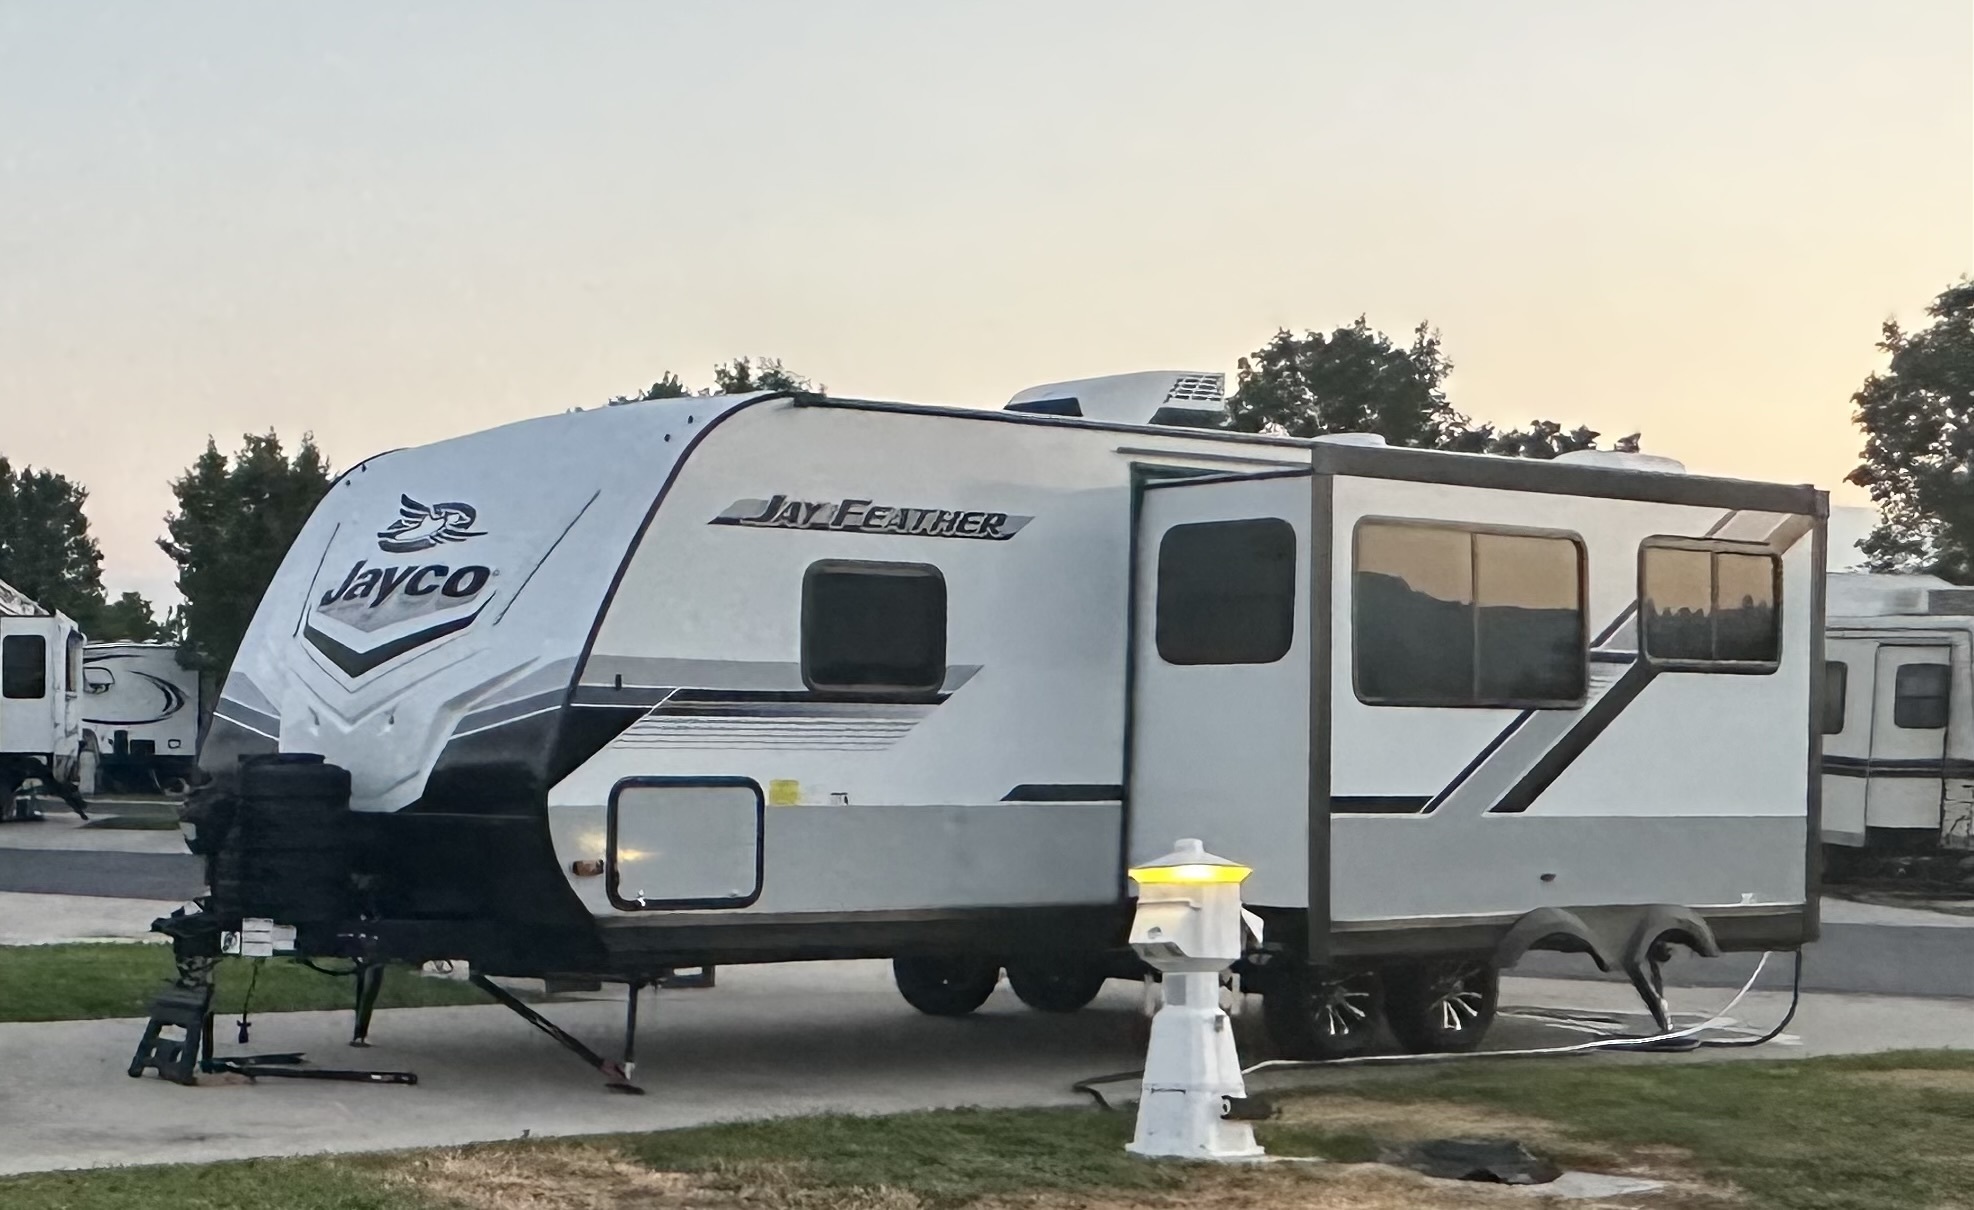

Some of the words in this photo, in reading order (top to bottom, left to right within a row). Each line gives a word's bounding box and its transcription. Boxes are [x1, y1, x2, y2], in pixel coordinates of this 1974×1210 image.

[743, 494, 823, 525] JAY
[831, 499, 1008, 537] FEATHER
[319, 559, 491, 609] Jayco
